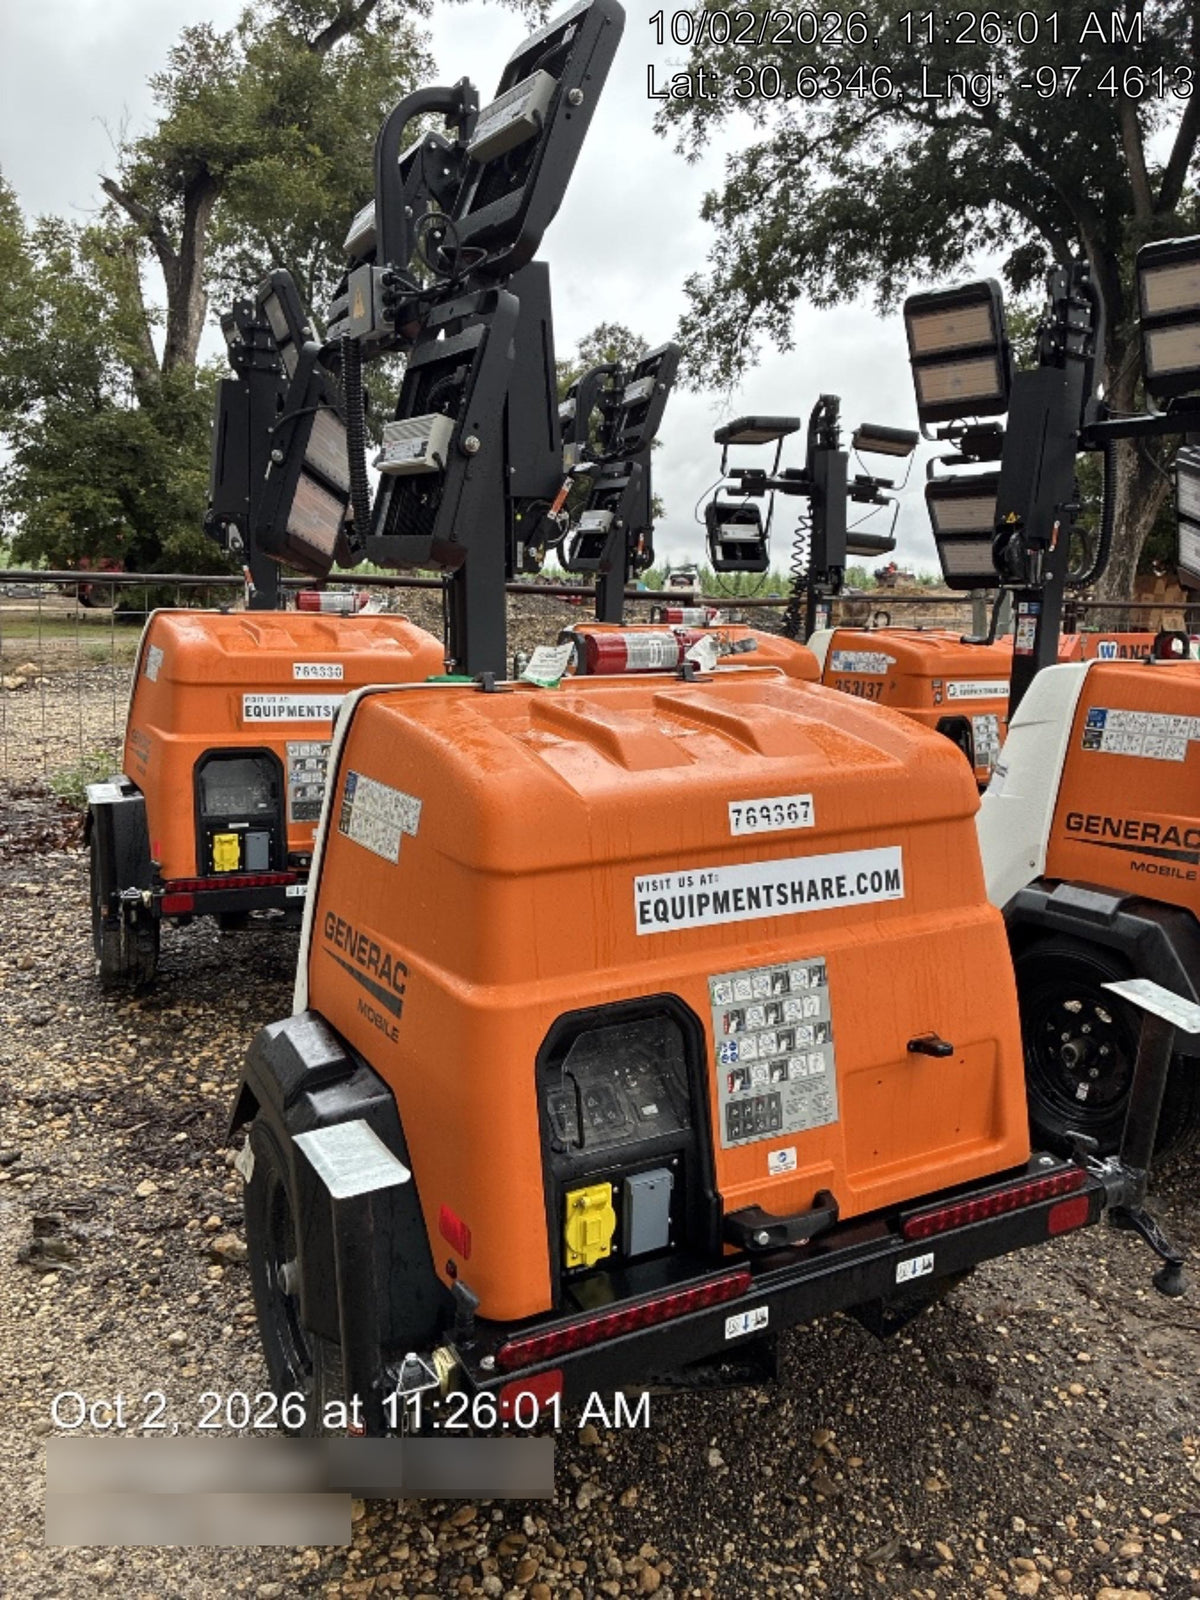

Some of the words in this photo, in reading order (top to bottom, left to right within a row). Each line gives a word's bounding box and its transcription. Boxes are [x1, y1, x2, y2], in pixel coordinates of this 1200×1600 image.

[731, 801, 811, 828] 769367
[1066, 812, 1200, 849] GENERAC
[637, 878, 671, 893] VISIT
[678, 876, 694, 888] US
[699, 873, 719, 886] AT:
[1130, 860, 1197, 881] MOBILE
[639, 868, 901, 925] EQUIPMENTSHARE.COM
[324, 911, 408, 995] GENERAC
[357, 998, 401, 1044] MOBILE
